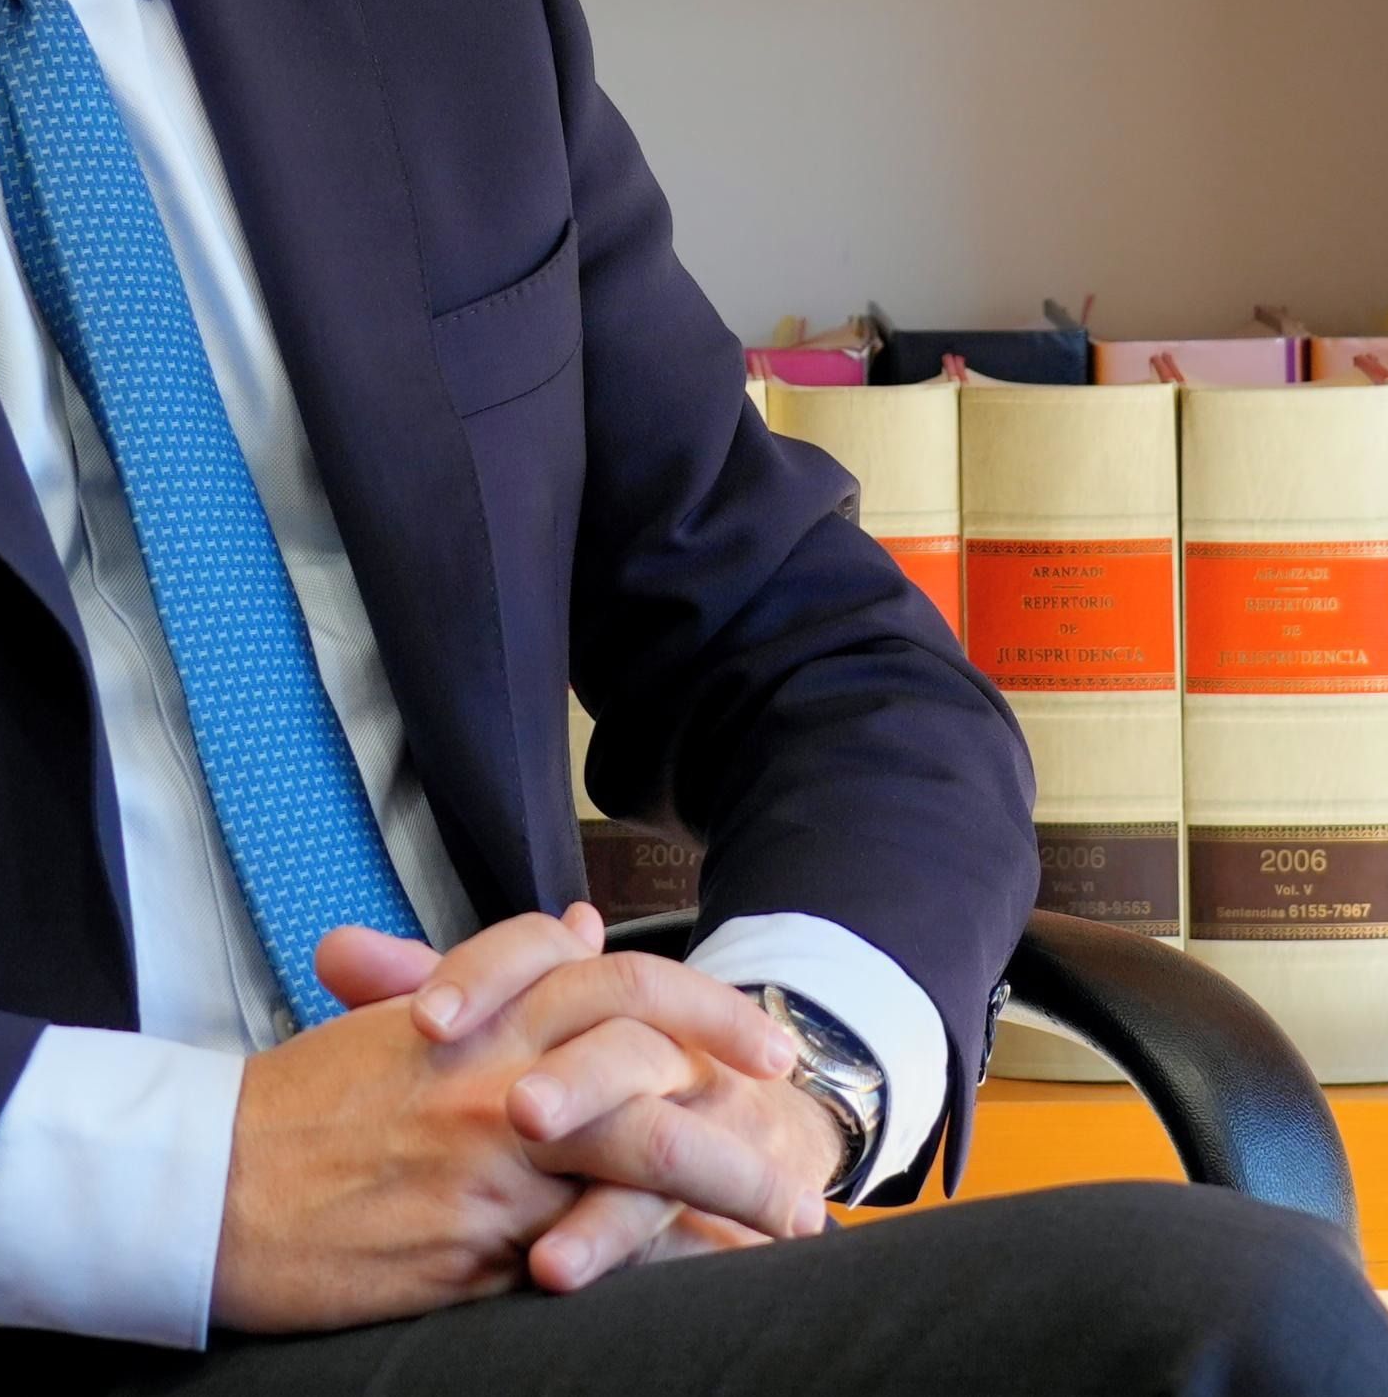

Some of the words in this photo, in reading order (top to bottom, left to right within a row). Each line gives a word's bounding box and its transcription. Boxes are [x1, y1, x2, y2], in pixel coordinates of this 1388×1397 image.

[1041, 846, 1106, 869] 2006
[1259, 849, 1327, 872] 2006
[1275, 884, 1301, 896] Vol.
[1303, 884, 1313, 895] V
